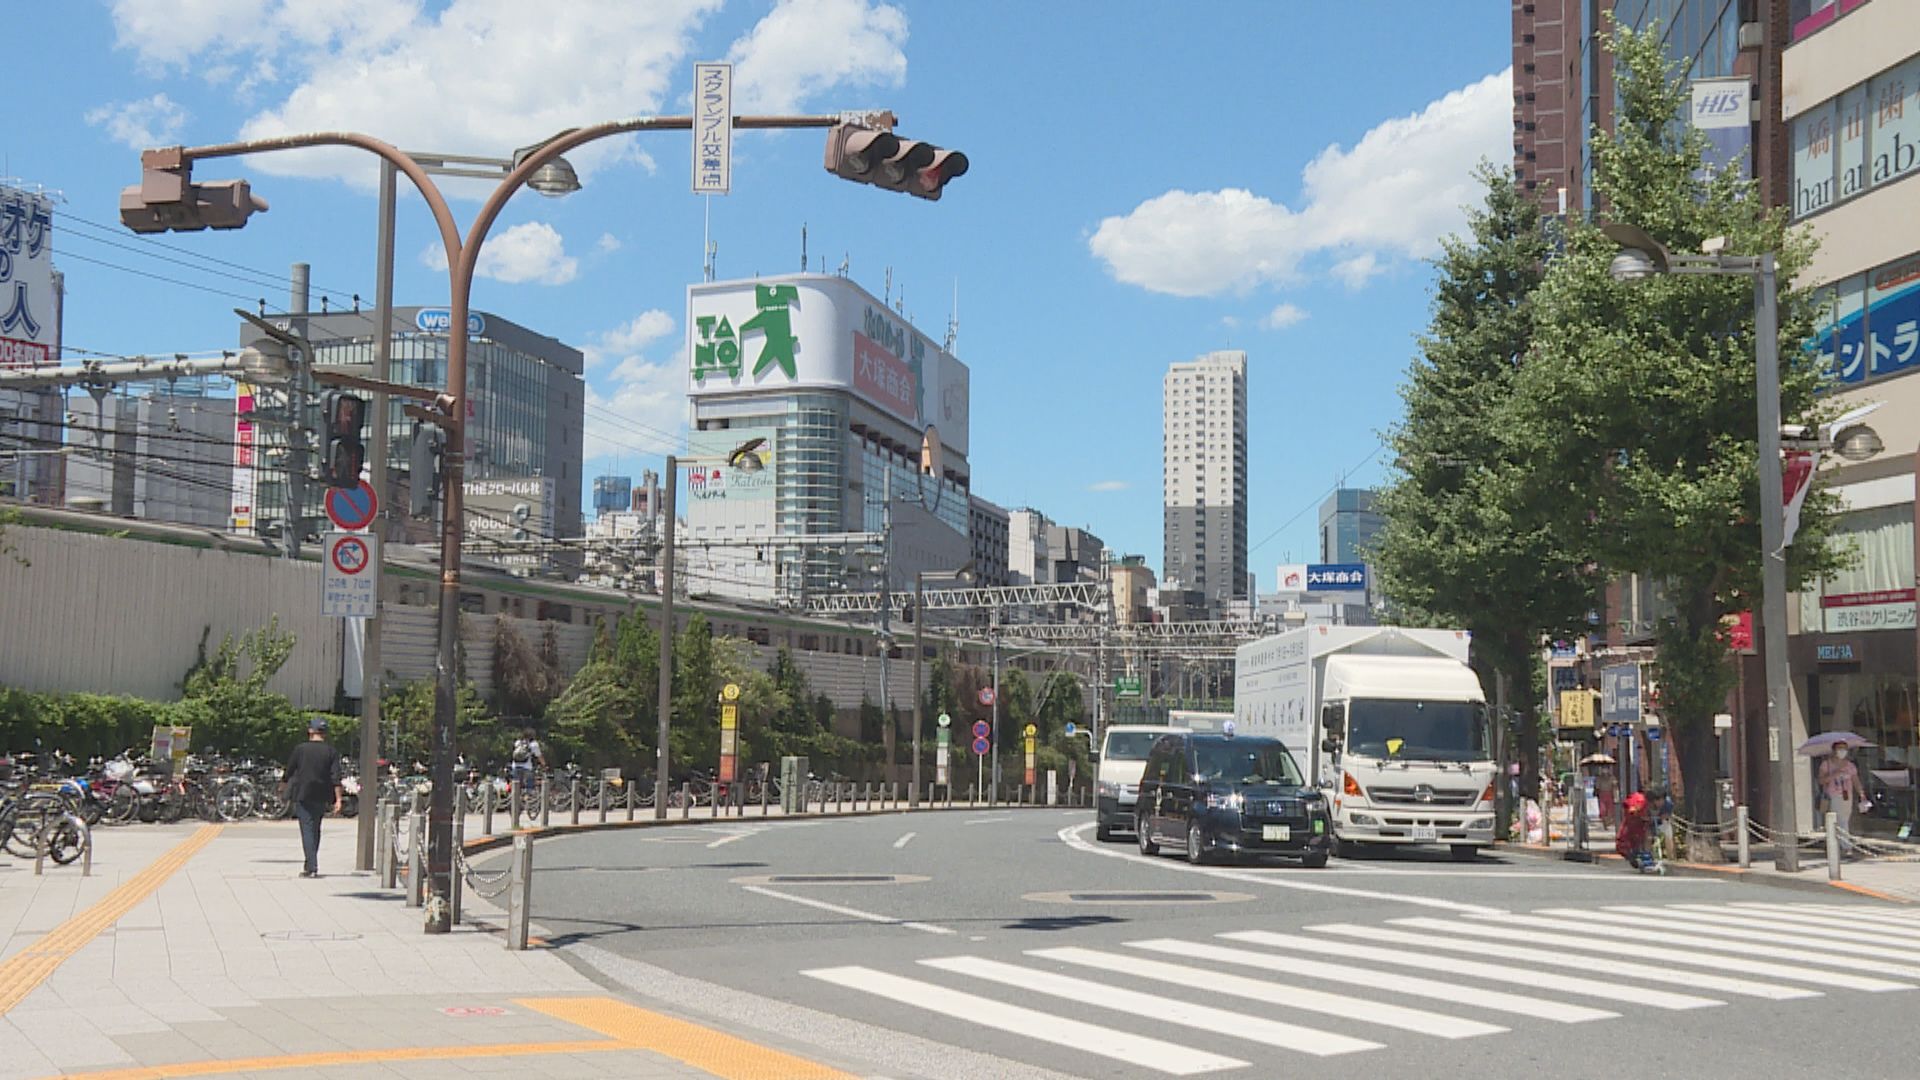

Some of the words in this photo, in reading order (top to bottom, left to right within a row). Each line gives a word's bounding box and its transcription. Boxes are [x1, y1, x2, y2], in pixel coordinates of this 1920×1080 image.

[1696, 94, 1744, 113] HIS
[702, 69, 724, 187] スクランブル交差点
[0, 197, 51, 259] オケ
[859, 351, 912, 406] 大塚商会
[463, 482, 541, 496] THEグローバル社
[469, 514, 511, 538] global
[1308, 571, 1363, 584] 大塚商会
